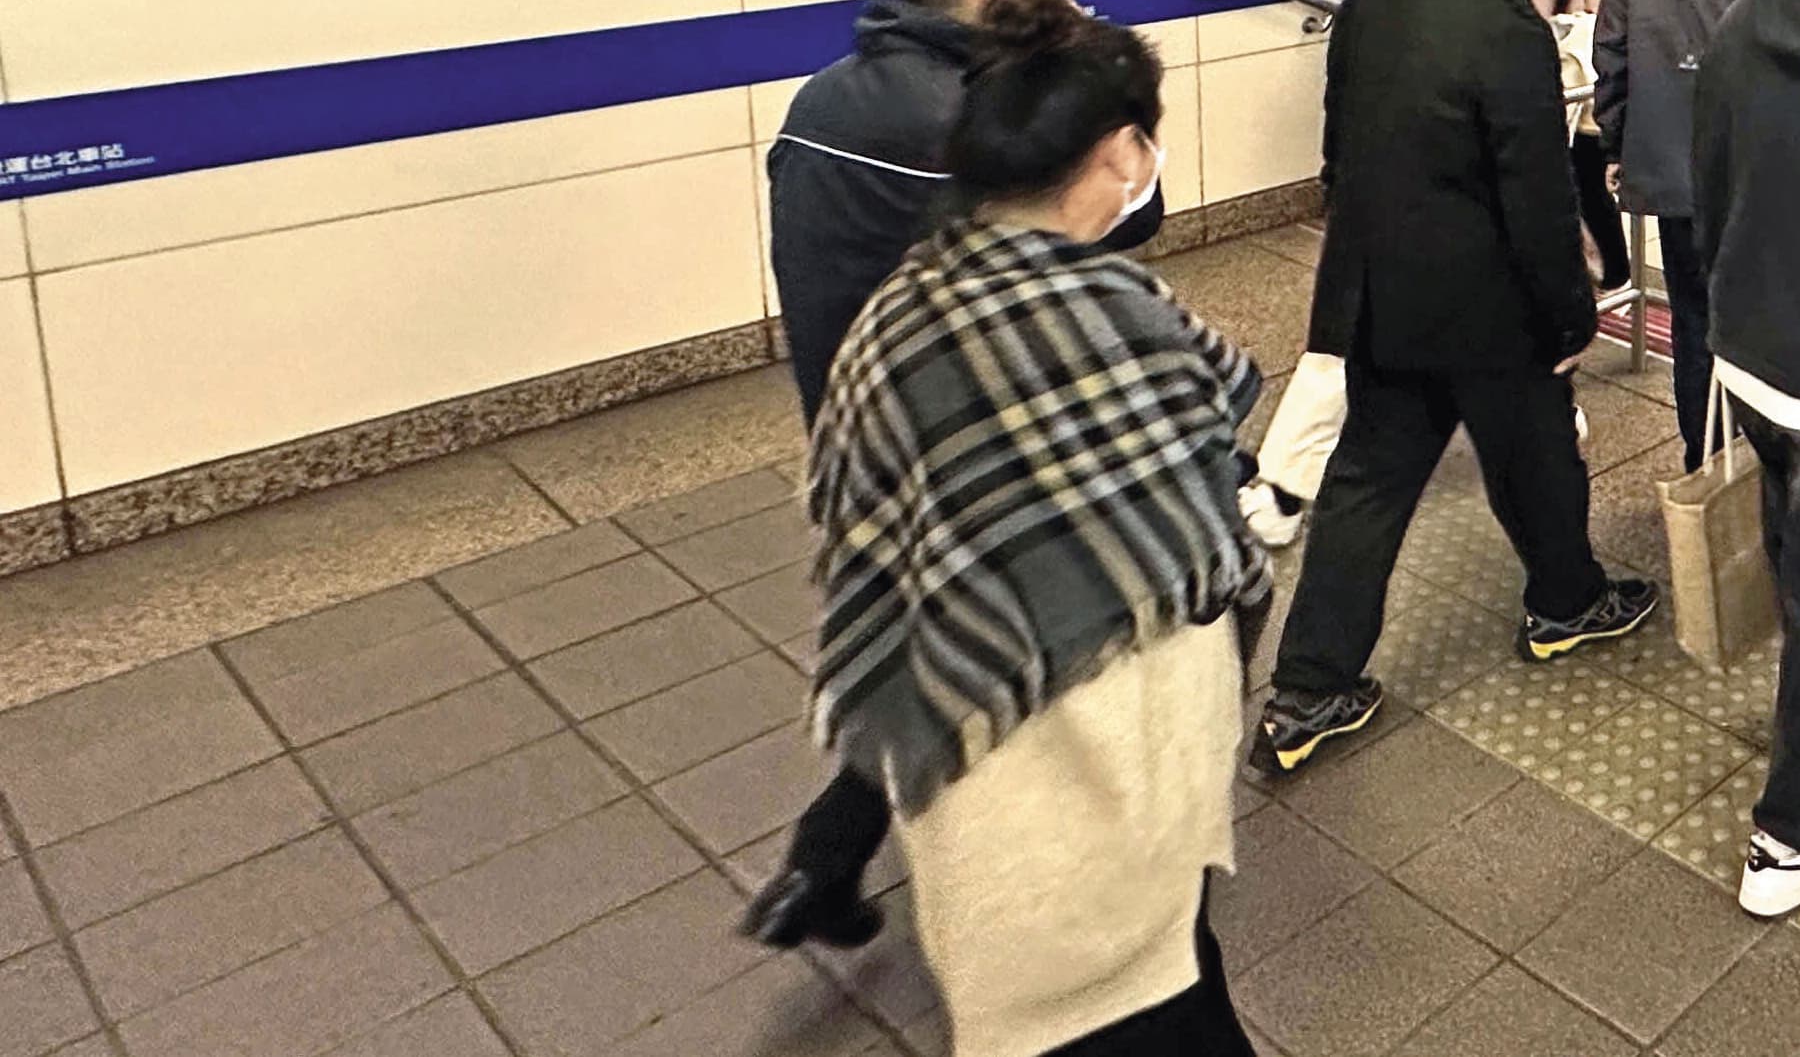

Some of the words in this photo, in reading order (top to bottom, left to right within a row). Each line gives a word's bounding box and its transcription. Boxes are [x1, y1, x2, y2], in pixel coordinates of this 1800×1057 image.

[0, 143, 124, 174] 運台北車站
